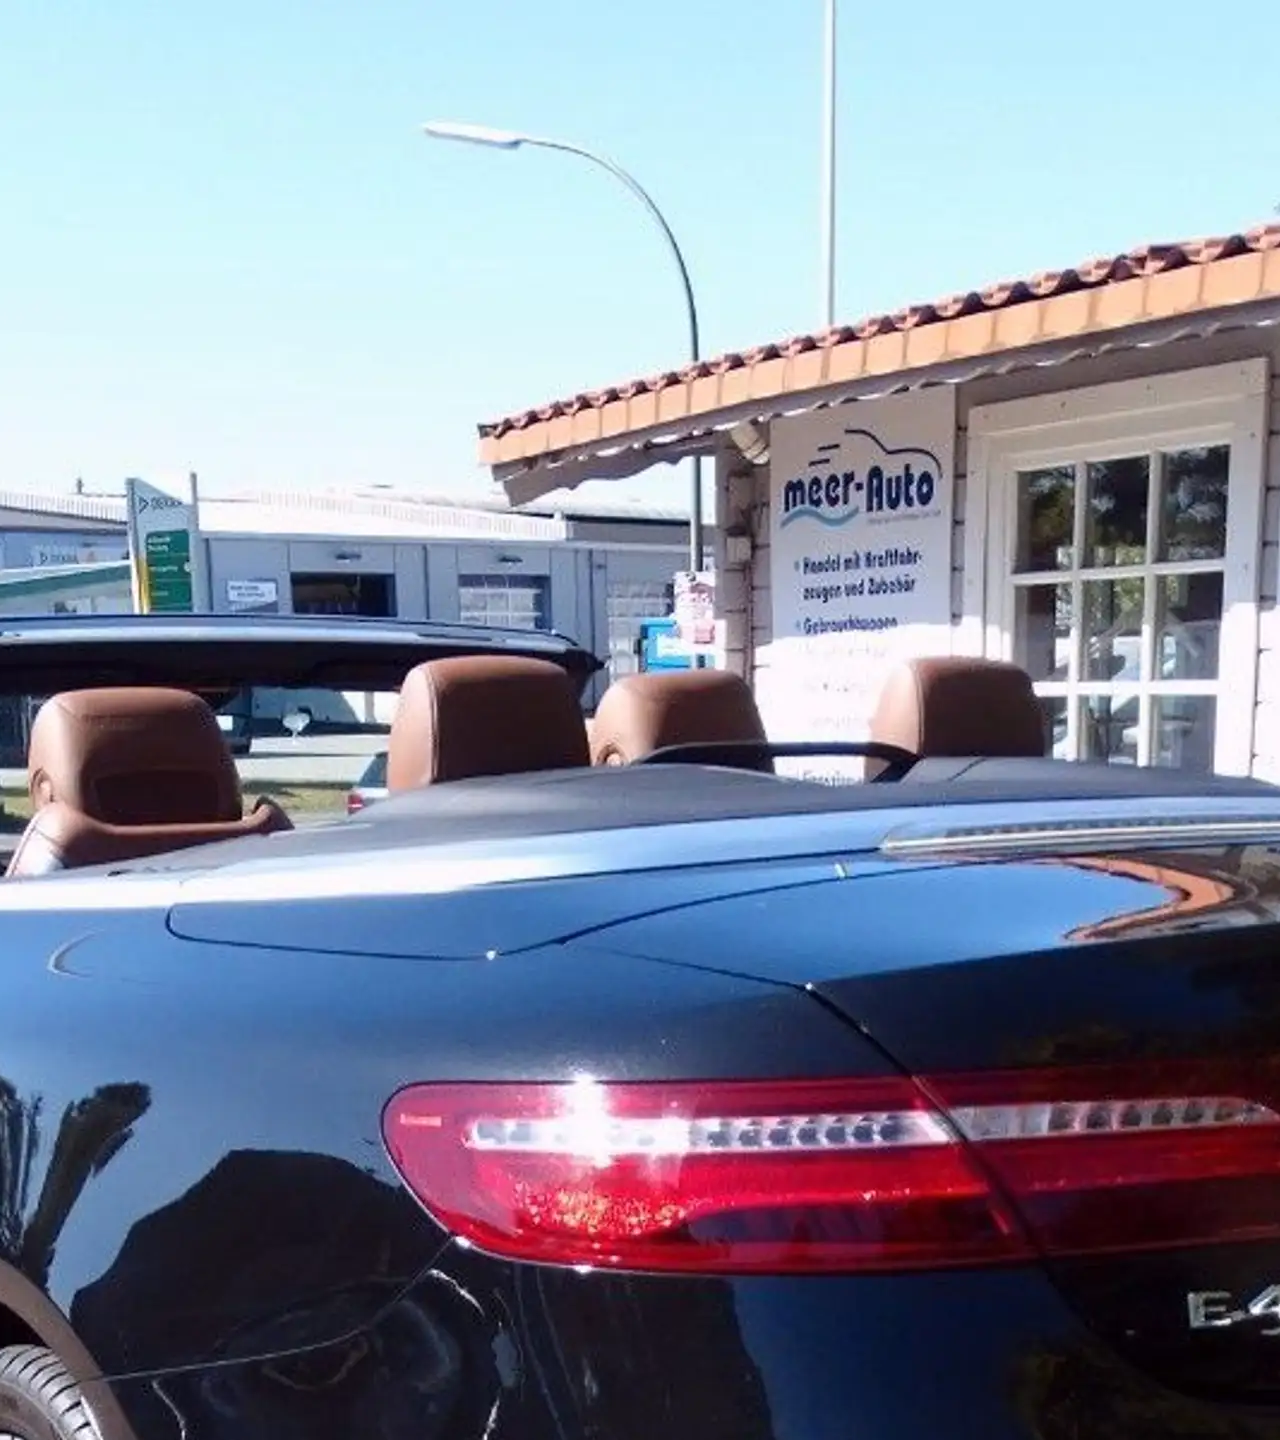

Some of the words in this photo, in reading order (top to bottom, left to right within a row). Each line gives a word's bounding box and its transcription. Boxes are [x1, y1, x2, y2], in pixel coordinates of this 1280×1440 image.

[783, 463, 935, 513] meer-Auto
[802, 554, 840, 575] Handel
[843, 549, 860, 571] mit
[844, 578, 865, 597] und
